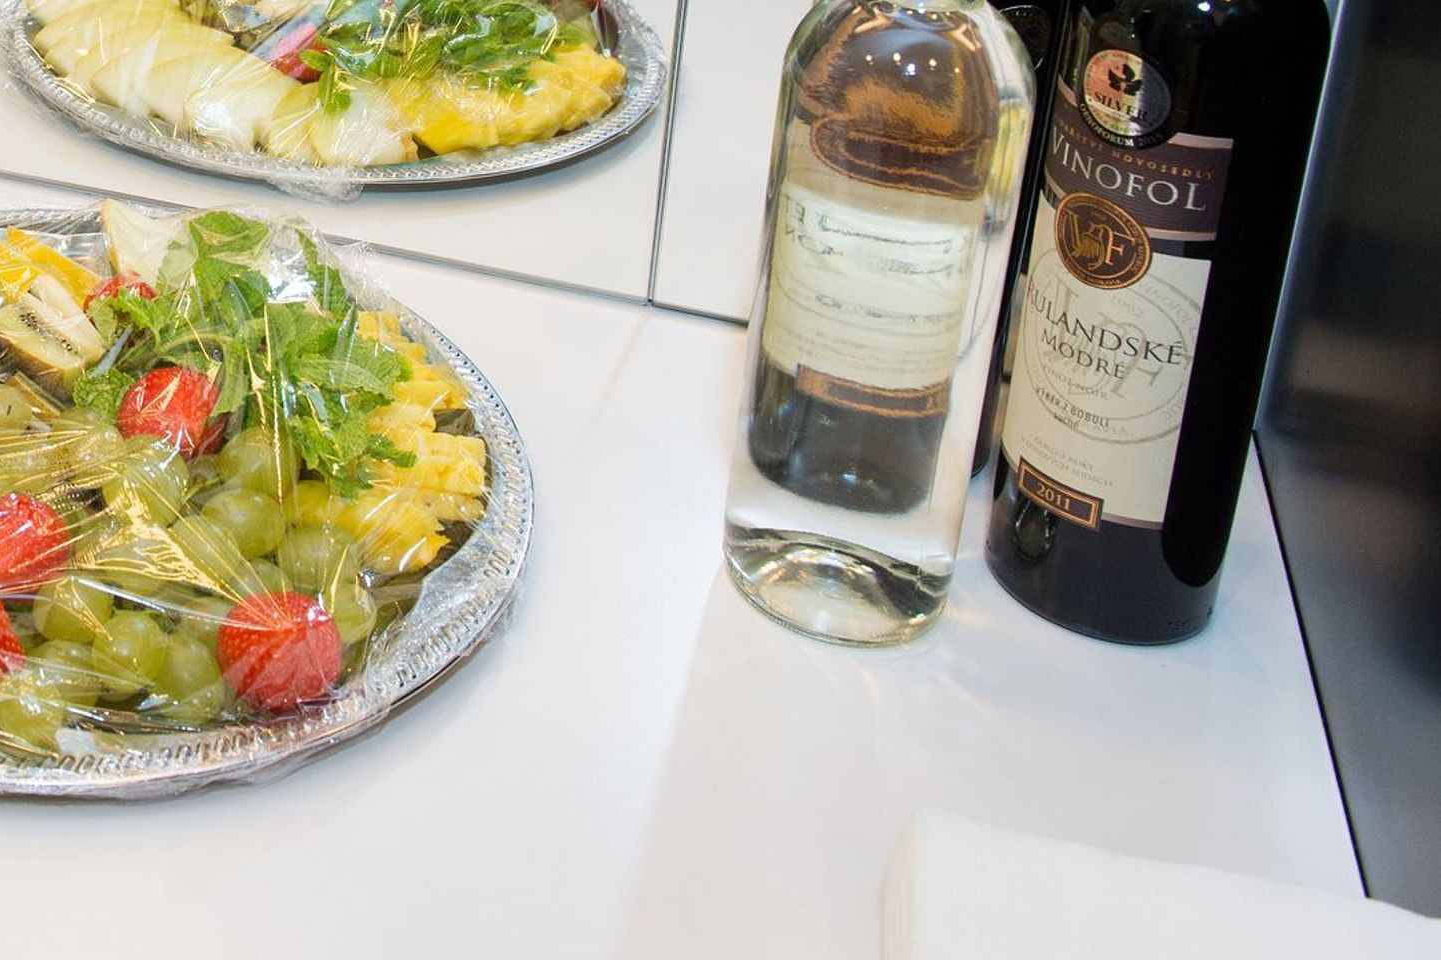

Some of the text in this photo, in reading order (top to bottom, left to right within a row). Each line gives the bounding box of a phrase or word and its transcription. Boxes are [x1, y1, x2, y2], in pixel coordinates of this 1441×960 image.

[1050, 125, 1207, 211] VINOFOL
[1027, 279, 1184, 365] RULANDSKÉ
[1040, 328, 1127, 380] MODRÉ
[1036, 482, 1072, 512] 2011
